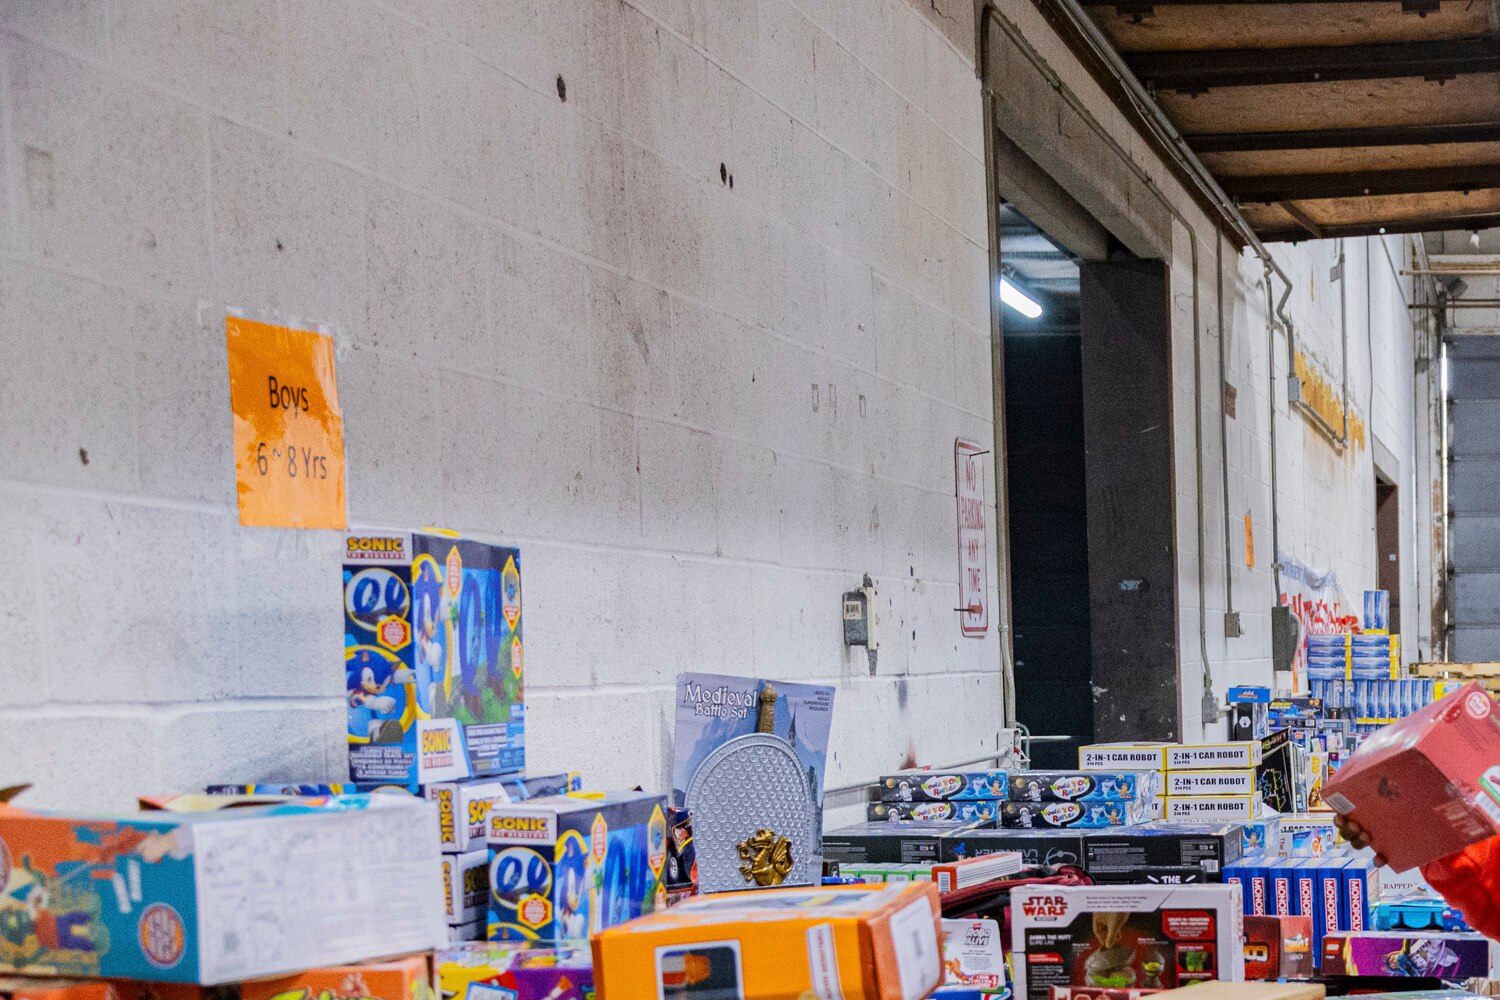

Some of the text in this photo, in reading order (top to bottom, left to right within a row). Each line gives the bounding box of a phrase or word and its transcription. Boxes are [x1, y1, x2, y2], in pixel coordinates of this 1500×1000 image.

[268, 375, 309, 419] Boys
[257, 442, 268, 476] 6
[288, 445, 297, 478] 8
[302, 446, 327, 480] Yrs
[965, 459, 976, 491] NO
[347, 537, 404, 551] SONIC
[684, 680, 758, 707] Medieval
[695, 702, 748, 719] Battle Set
[422, 730, 452, 754] SONIC
[1086, 753, 1158, 762] 2-IN-1 CAR ROBOT
[1173, 750, 1244, 761] 2-IN-1 CAR ROBOT
[1174, 777, 1246, 787] 2-IN-1 CAR ROBOT
[1173, 802, 1244, 812] 2-IN-1 CAR ROBOT
[439, 789, 455, 845] SONIC
[492, 816, 548, 831] SONIC
[1161, 875, 1181, 884] THE
[1022, 896, 1068, 906] STAR
[1023, 905, 1068, 916] WARS
[965, 928, 991, 938] ROBO
[964, 936, 990, 946] ALIVE
